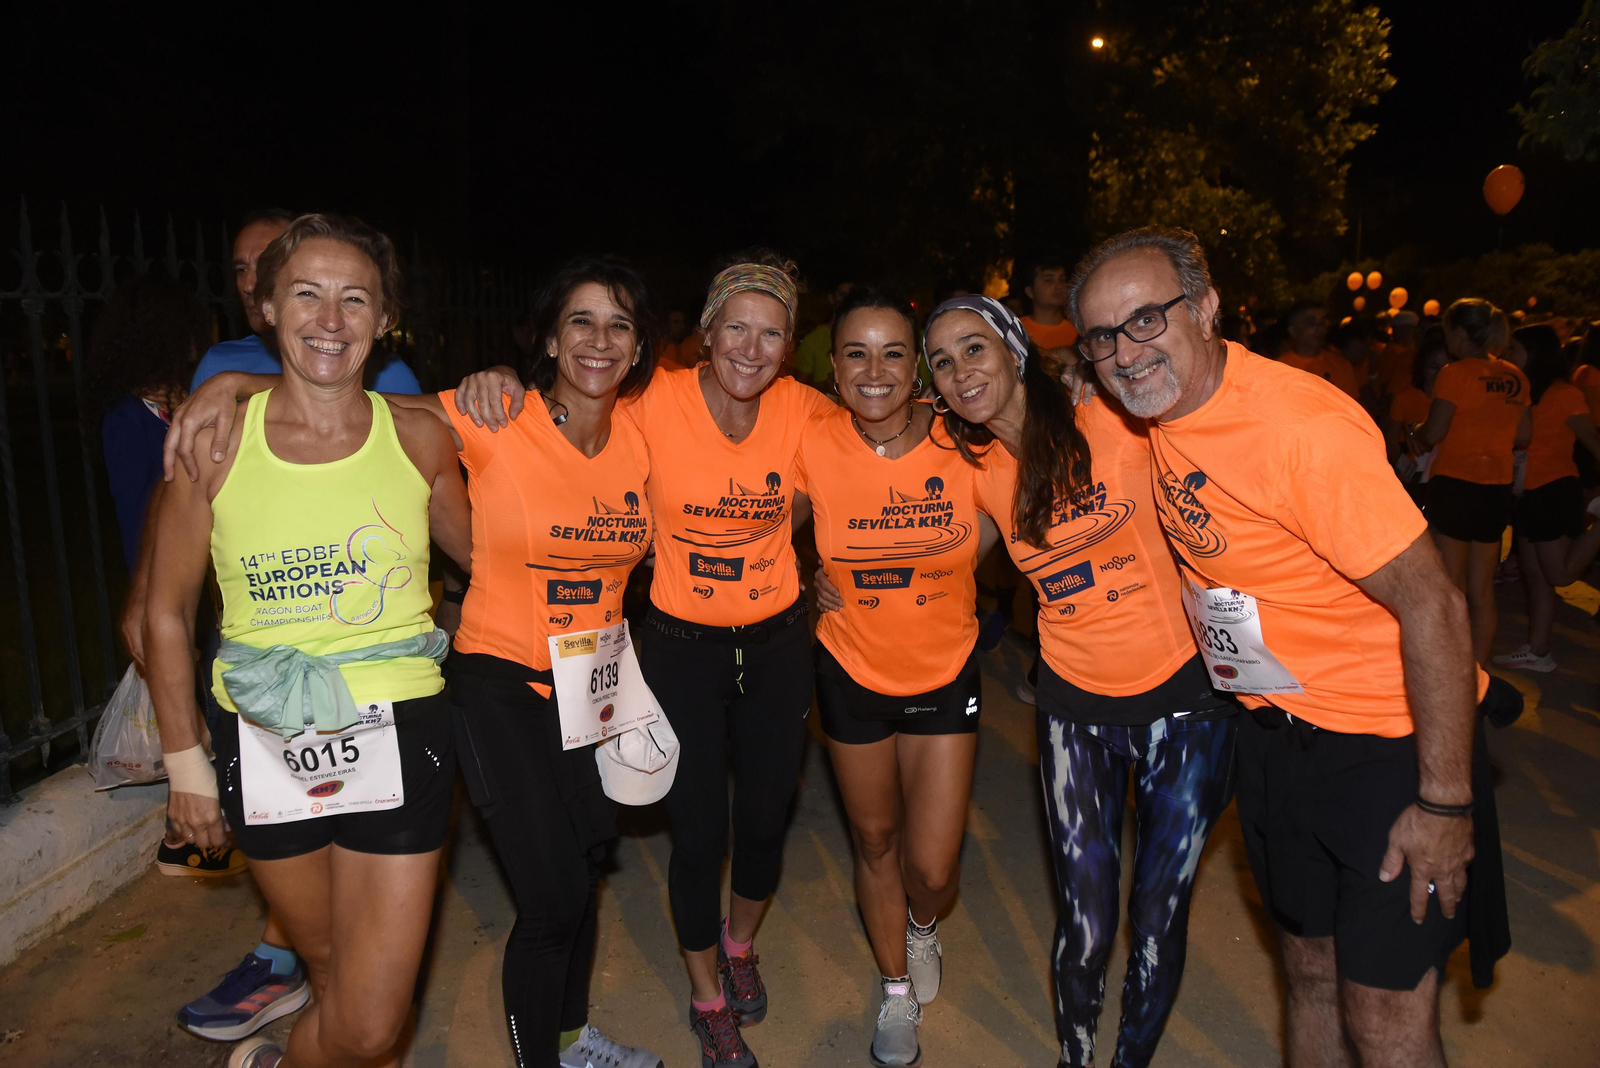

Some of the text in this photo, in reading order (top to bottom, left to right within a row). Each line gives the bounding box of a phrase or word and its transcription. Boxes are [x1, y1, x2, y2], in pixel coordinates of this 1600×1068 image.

[718, 495, 786, 508] NOCTURNA
[881, 501, 954, 516] NOCTURNA
[682, 503, 750, 519] SEVILLA
[587, 516, 647, 528] NOCTURNA
[847, 517, 915, 530] SEVILLA
[550, 525, 616, 542] SEVILLA
[240, 544, 341, 571] 14TH EDBF
[245, 560, 367, 587] EUROPEAN
[248, 579, 345, 602] NATIONS
[295, 603, 323, 614] BOAT
[250, 612, 332, 627] CHAMPIONSHIPS
[590, 661, 619, 694] 6139
[283, 736, 360, 772] 6015
[310, 771, 337, 781] ESTEVEZ
[338, 767, 356, 776] EIRAS
